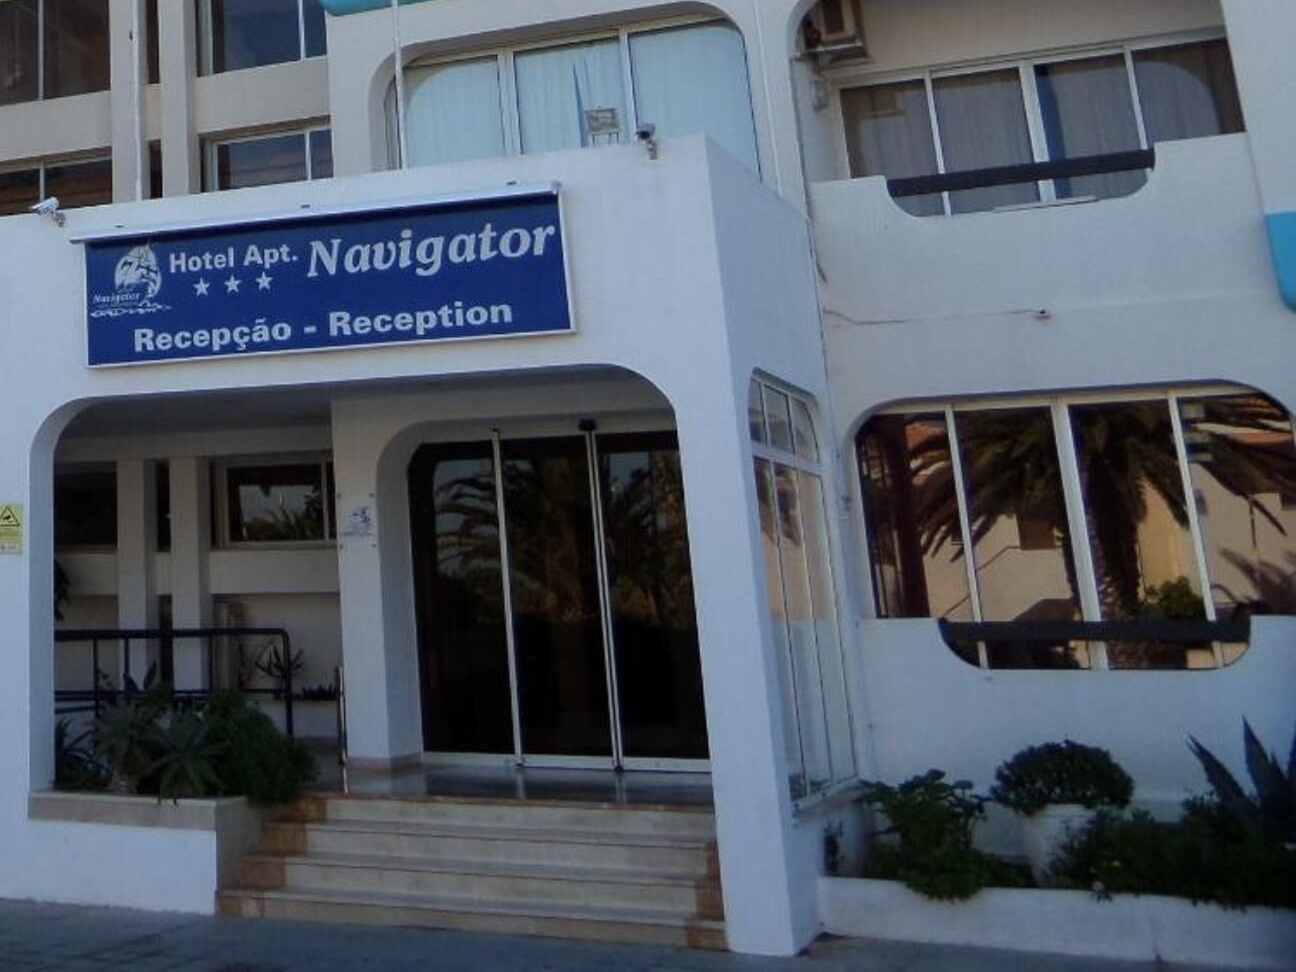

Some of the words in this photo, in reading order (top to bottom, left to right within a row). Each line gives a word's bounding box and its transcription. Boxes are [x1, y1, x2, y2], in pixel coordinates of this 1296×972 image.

[169, 246, 235, 274] Hotel
[242, 243, 299, 270] Apt.
[306, 222, 555, 278] Navigator
[133, 317, 292, 352] Recepção
[329, 300, 513, 337] Reception
